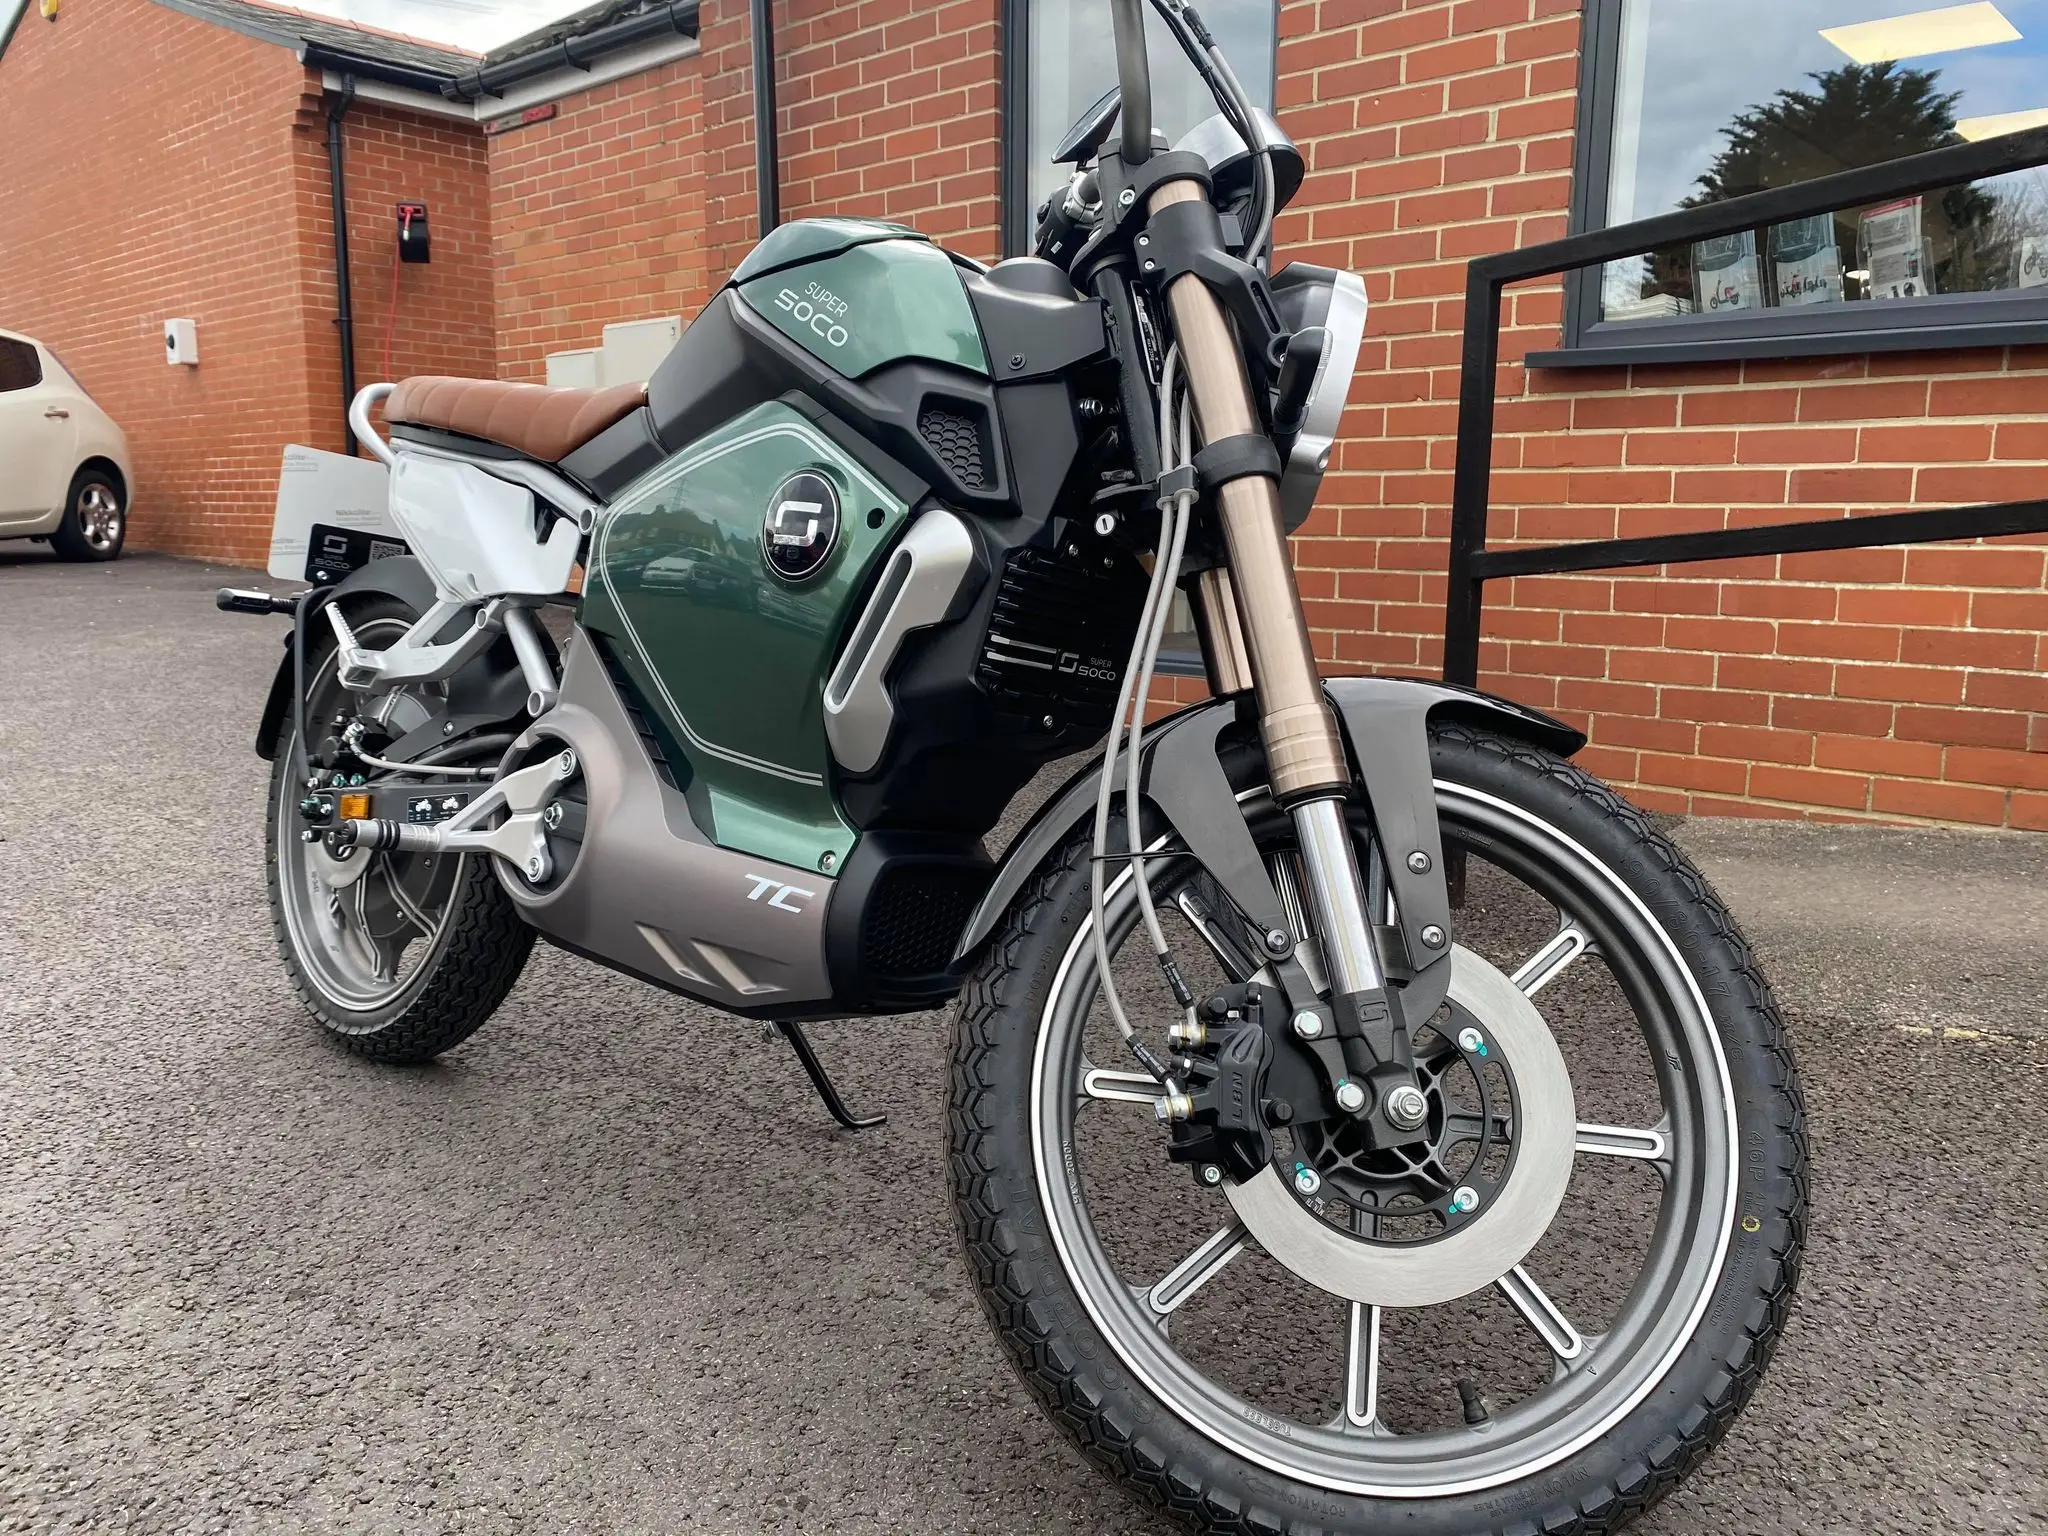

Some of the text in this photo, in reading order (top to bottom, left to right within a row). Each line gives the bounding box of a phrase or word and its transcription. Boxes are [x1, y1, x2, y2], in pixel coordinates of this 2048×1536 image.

[774, 288, 849, 347] SOCO
[804, 281, 848, 318] SUPER
[1077, 665, 1116, 681] SOCO
[1090, 657, 1112, 668] SUPER
[744, 873, 816, 914] TC
[1746, 1130, 1767, 1182] 46P
